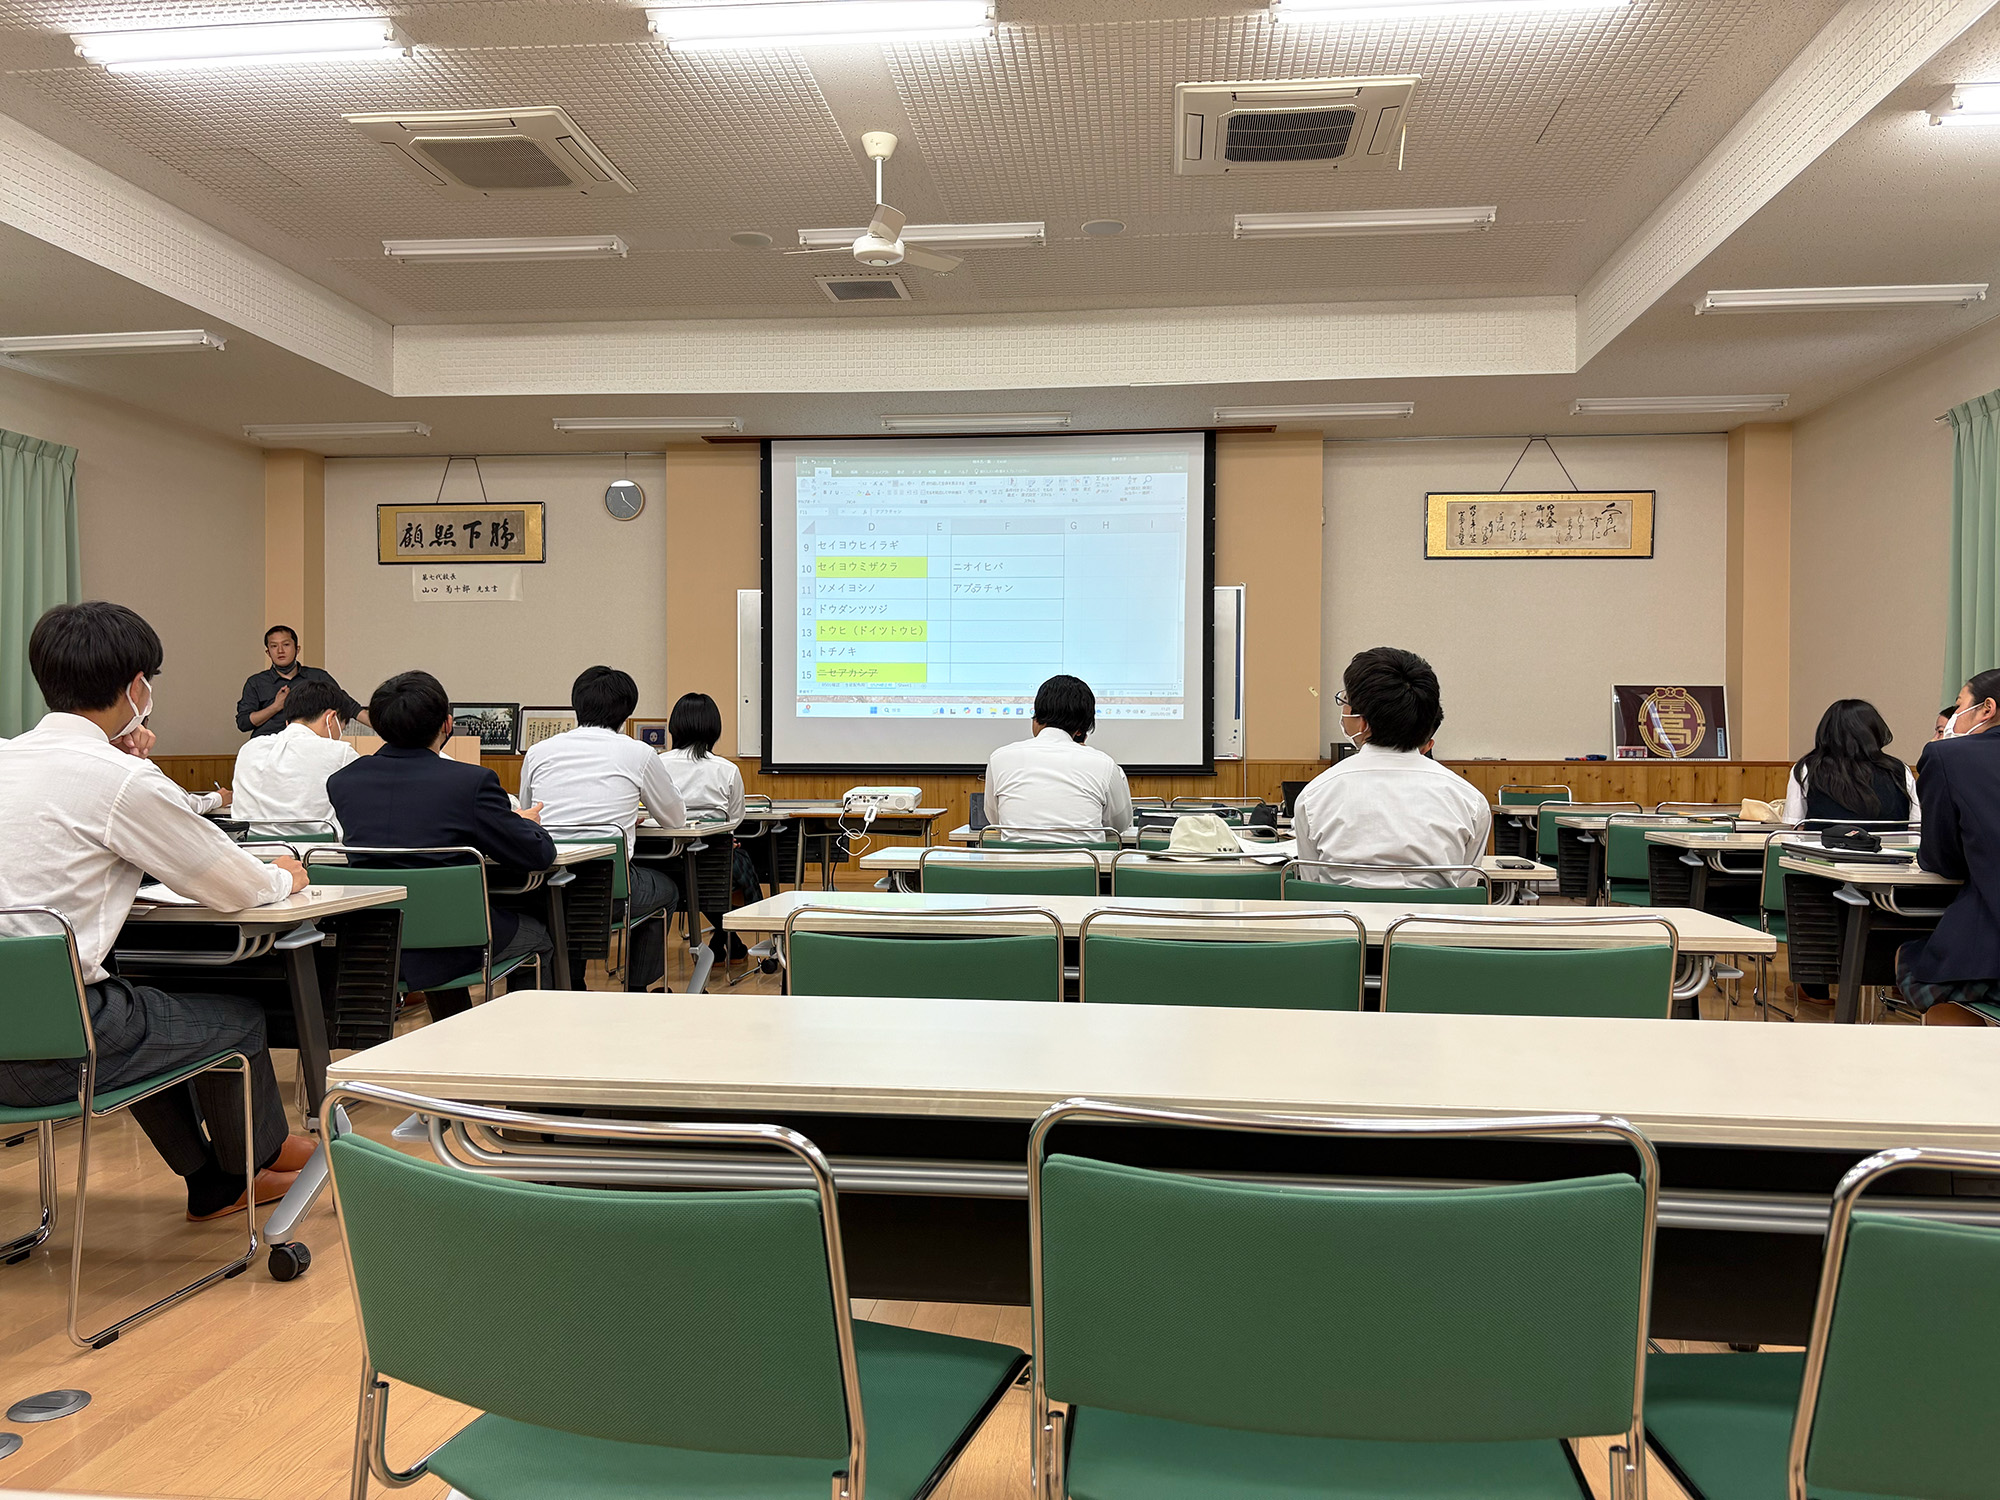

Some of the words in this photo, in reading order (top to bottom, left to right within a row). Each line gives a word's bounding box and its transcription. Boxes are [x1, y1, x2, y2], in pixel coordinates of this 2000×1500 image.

[868, 522, 876, 531] D
[936, 522, 943, 531] E
[1005, 521, 1011, 531] F
[1070, 521, 1078, 530] G
[1102, 520, 1110, 530] H
[803, 544, 810, 552] 9
[817, 540, 899, 550] セイヨウヒイラギ
[801, 565, 812, 573] 10
[817, 561, 899, 572] セイヨウミザクラ
[801, 586, 811, 595] 11
[818, 583, 876, 593] ソメイヨシノ
[953, 583, 1014, 594] アブラチャン
[801, 607, 812, 616] 12
[819, 604, 888, 614] ドウダンツツジ
[801, 628, 812, 637] 13
[801, 649, 812, 658] 14
[819, 646, 857, 656] トチノキ
[801, 670, 812, 679] 15
